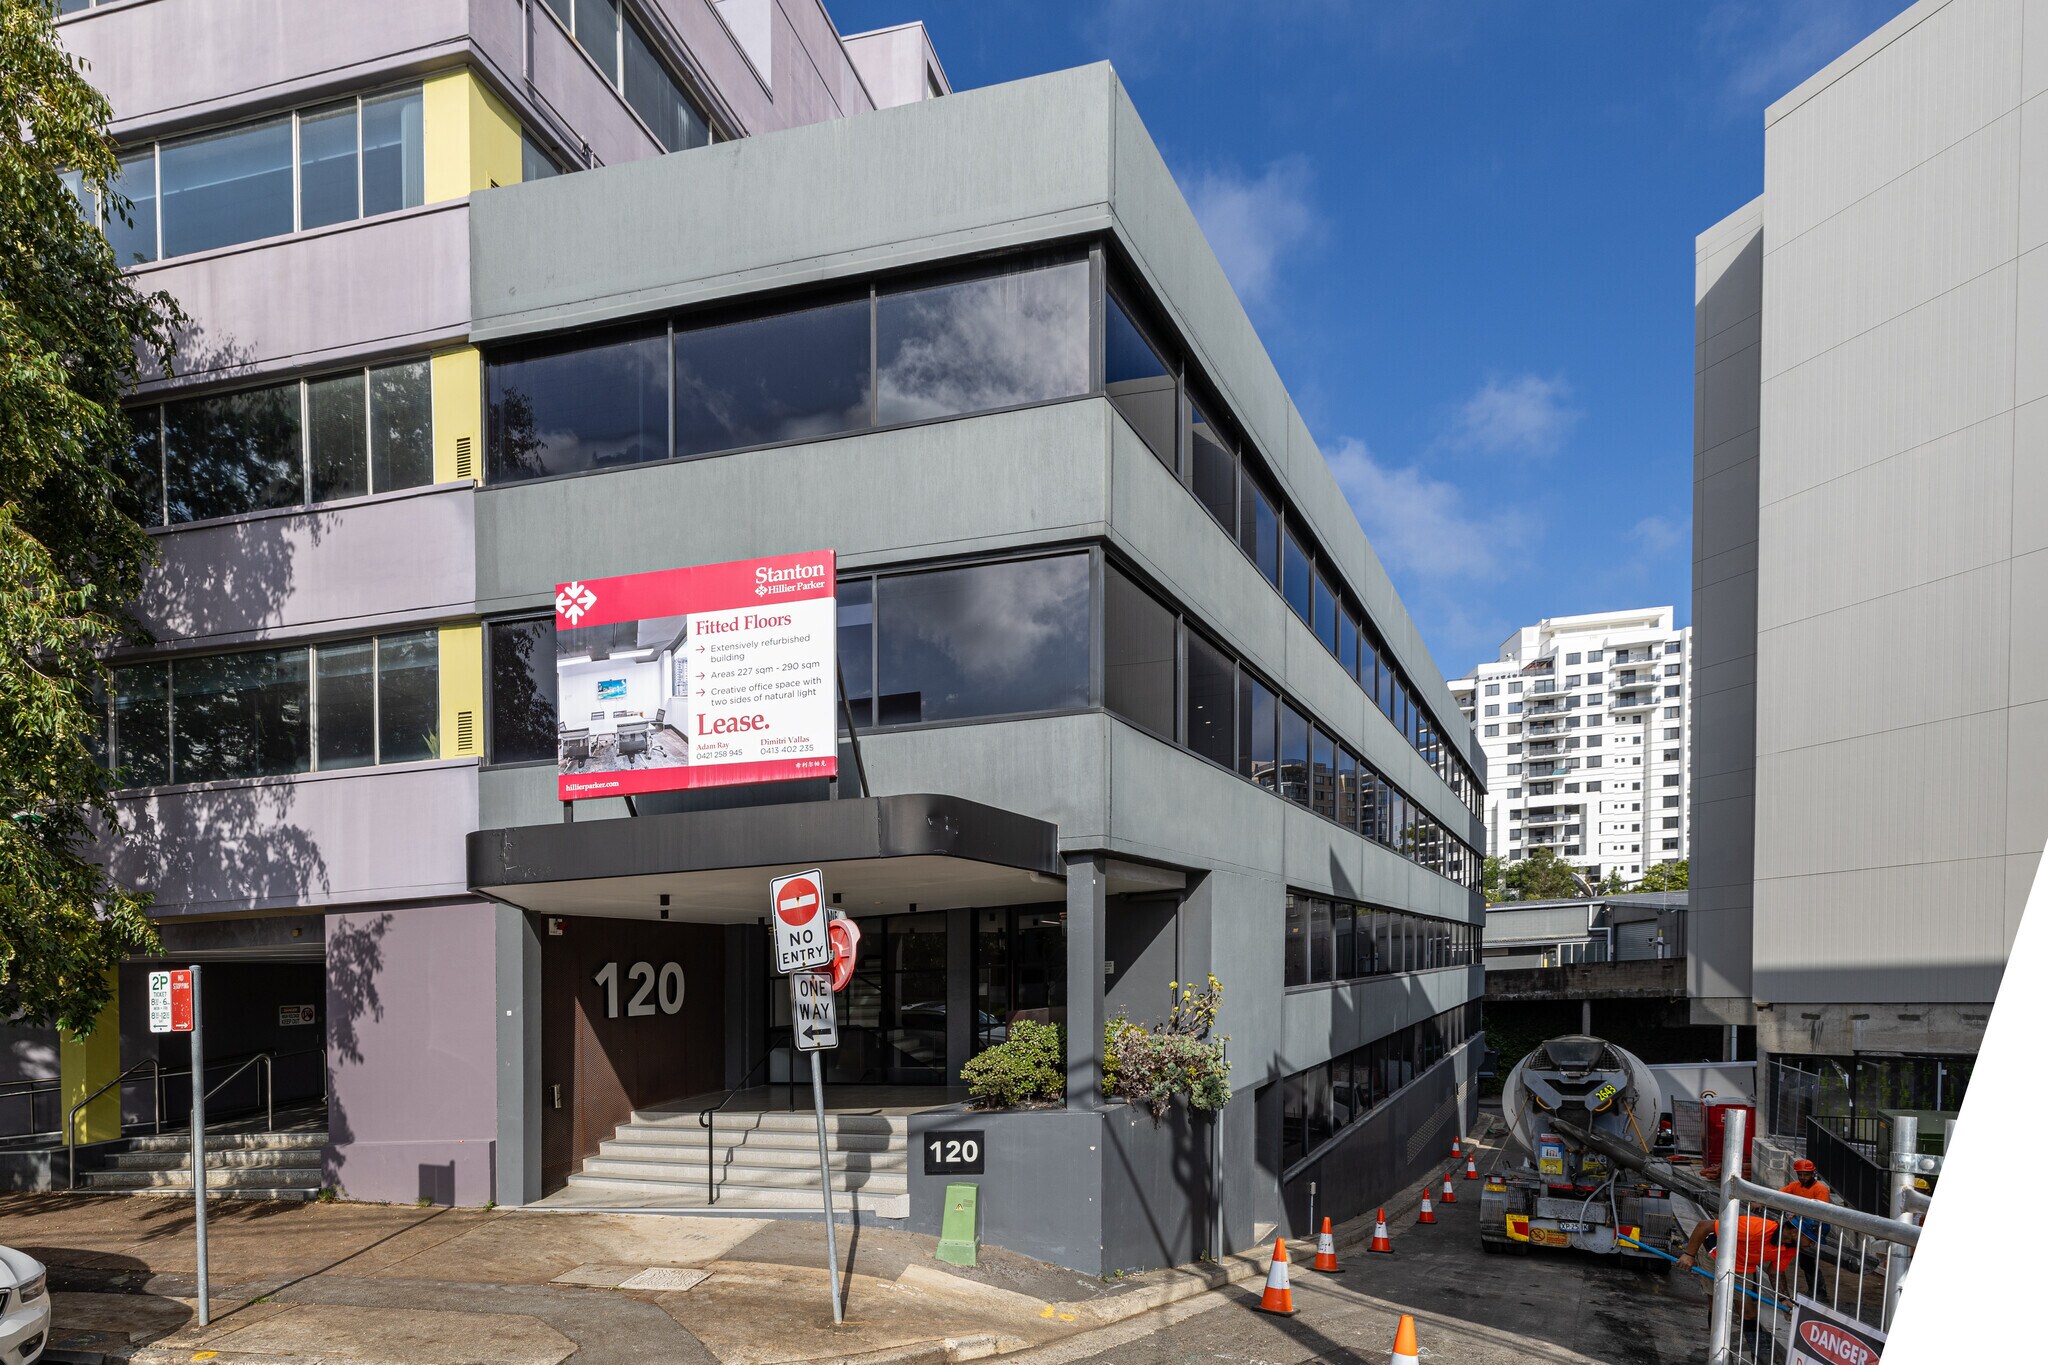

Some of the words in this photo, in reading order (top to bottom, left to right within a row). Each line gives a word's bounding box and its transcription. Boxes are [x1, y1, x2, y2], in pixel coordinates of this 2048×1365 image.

[755, 564, 825, 584] Stanton
[768, 584, 796, 595] Hillier
[797, 581, 825, 591] Parker
[696, 617, 739, 635] Fitted
[744, 614, 792, 630] Floors
[711, 640, 758, 653] Extensively
[761, 634, 811, 647] refurbished
[711, 653, 745, 663] building
[711, 670, 735, 679] Areas
[737, 667, 752, 677] 227
[755, 665, 773, 675] sqm
[782, 662, 799, 672] 290
[801, 660, 820, 670] sqm
[711, 684, 747, 696] Creative
[748, 682, 773, 692] office
[775, 679, 801, 690] space
[802, 676, 822, 686] with
[711, 698, 727, 706] two
[729, 696, 751, 704] sides
[753, 694, 763, 702] of
[764, 690, 795, 701] natural
[797, 688, 817, 698] light
[696, 713, 770, 736] Lease.
[696, 742, 716, 751] Adam
[717, 741, 730, 750] Ray
[760, 737, 787, 746] Dimitri
[788, 736, 810, 744] Vallas
[760, 747, 779, 755] 0413
[781, 745, 797, 753] 402
[799, 744, 814, 752] 235
[696, 752, 713, 760] 0421
[714, 751, 728, 759] 258
[728, 749, 743, 757] 945
[565, 781, 620, 792] hillierparker.com
[789, 929, 813, 947] NO
[782, 945, 824, 964] ENTRY
[152, 975, 168, 990] 2P
[594, 961, 685, 1018] 120
[800, 980, 827, 997] ONE
[799, 1003, 830, 1020] WAY
[1595, 1084, 1617, 1101] 2643
[929, 1140, 978, 1163] 120
[1809, 1324, 1868, 1365] DANGER
